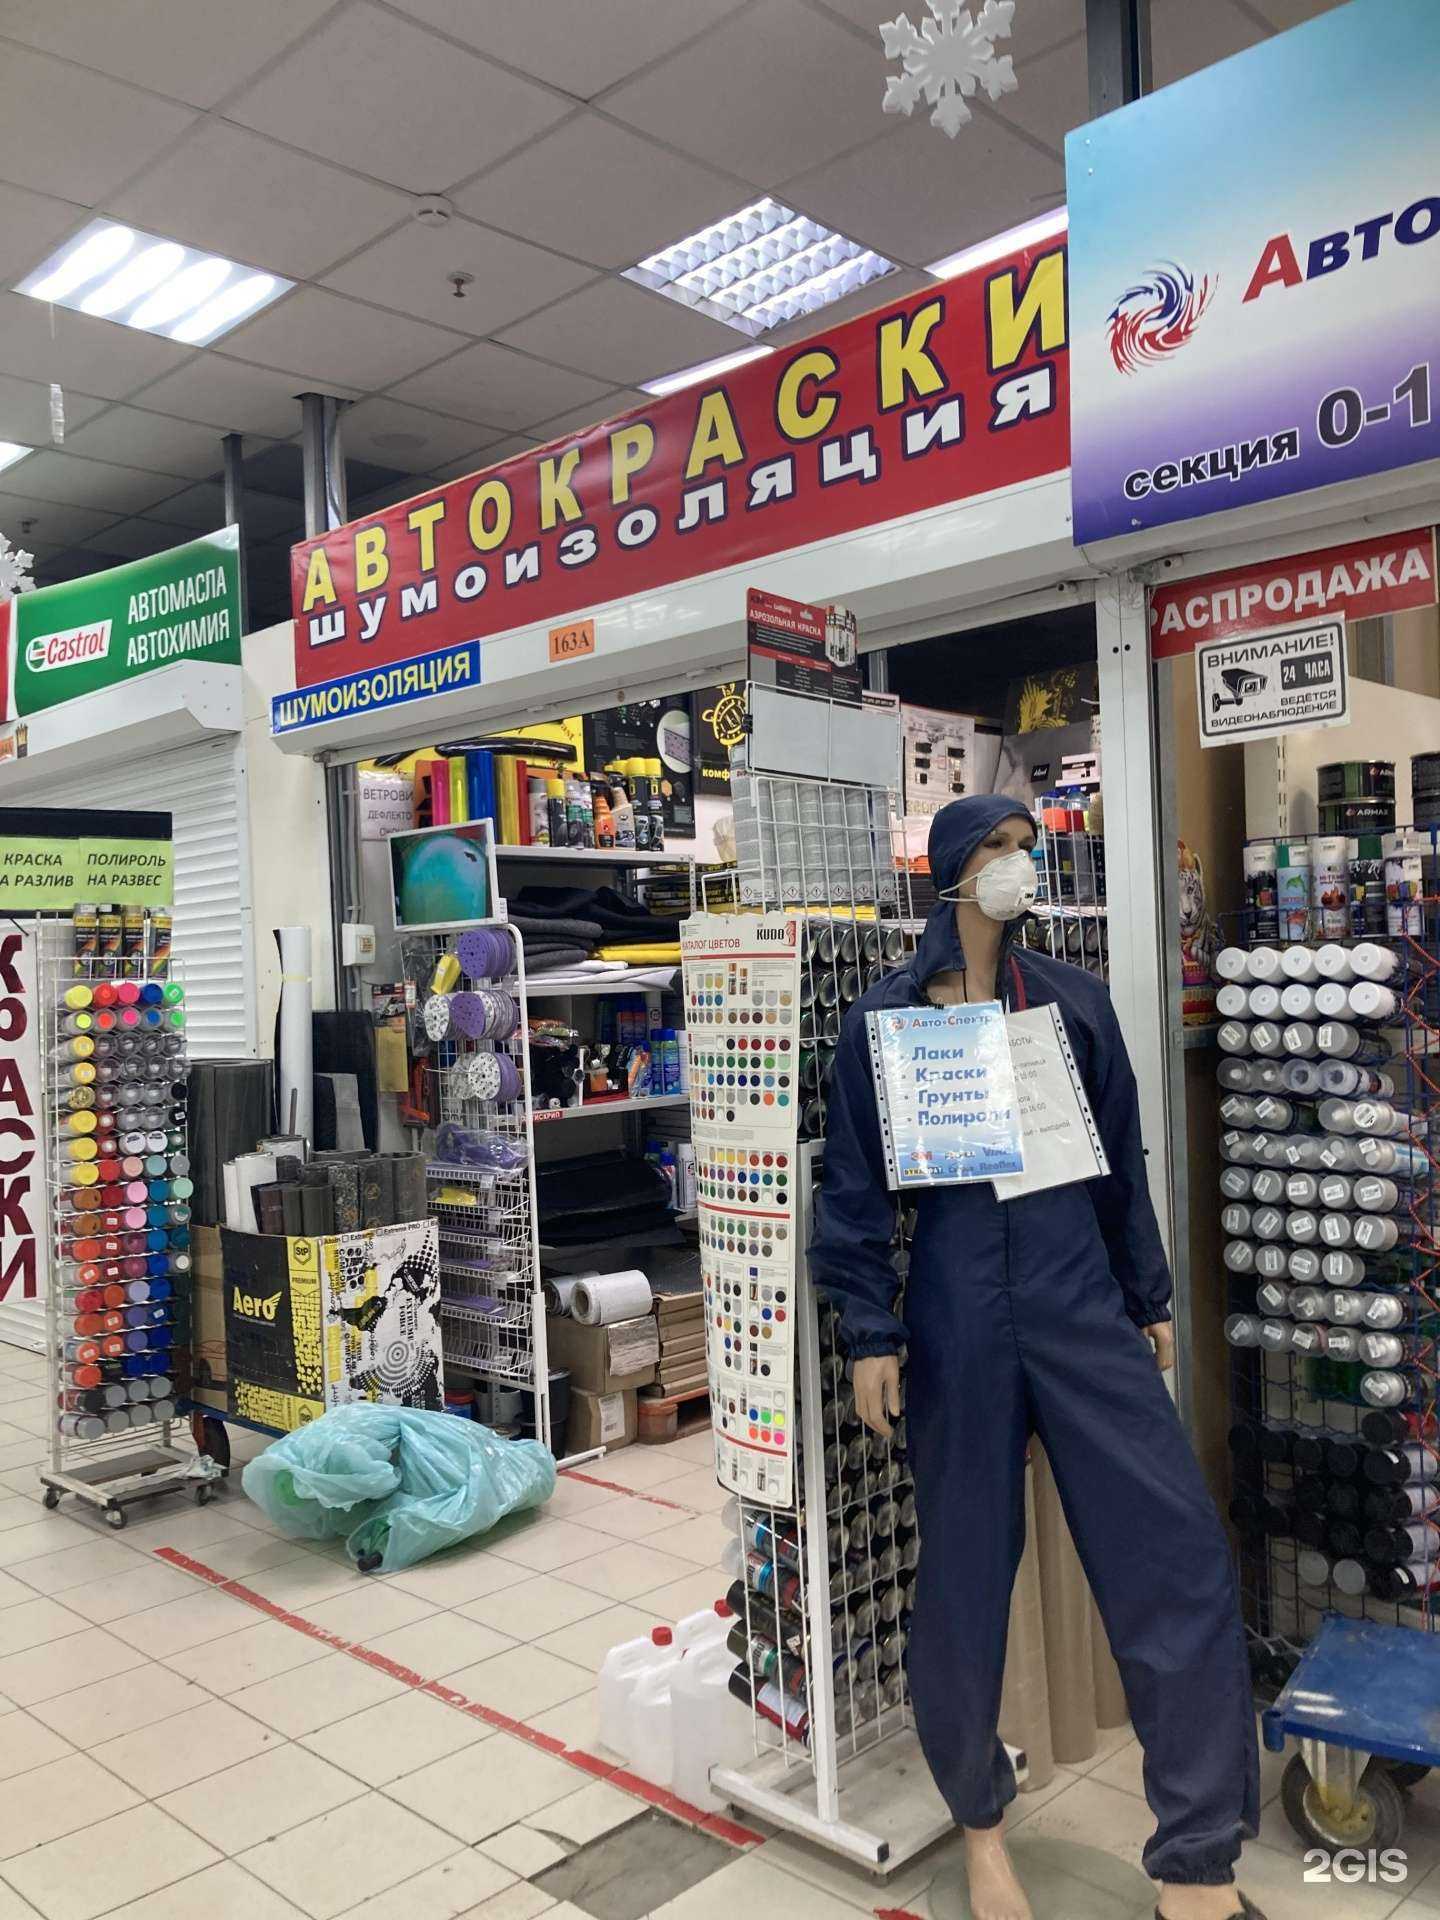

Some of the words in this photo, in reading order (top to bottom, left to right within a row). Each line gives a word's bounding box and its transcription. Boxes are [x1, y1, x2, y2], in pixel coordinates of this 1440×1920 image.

[1243, 197, 1440, 303] Авто
[302, 252, 1067, 612] АВТОКРАСКИ
[1125, 428, 1298, 499] секция
[309, 366, 1054, 646] шумоизоляция
[128, 566, 227, 624] АВТОМАСЛА
[47, 627, 105, 665] Castrol
[127, 609, 230, 667] АВТОХИМИЯ
[1207, 632, 1334, 668] ВНИМАНИЕ!
[1283, 664, 1296, 683] 24
[1305, 658, 1331, 678] ЧАСА
[280, 651, 471, 727] ШУМОИЗОЛЯЦИЯ
[1211, 700, 1337, 728] ВИДЕОНАБЛЮДЕНИЕ
[4, 853, 63, 866] КРАСКА
[87, 853, 166, 867] ПОЛИРОЛЬ
[0, 875, 9, 886] А
[15, 875, 74, 887] РАЗЛИВ
[87, 875, 107, 886] НА
[111, 874, 162, 886] РАЗВЕС
[708, 938, 741, 950] ЦВЕТОВ
[757, 928, 784, 940] KUDO
[912, 1047, 964, 1060] Лаки
[232, 1286, 282, 1320] Aero
